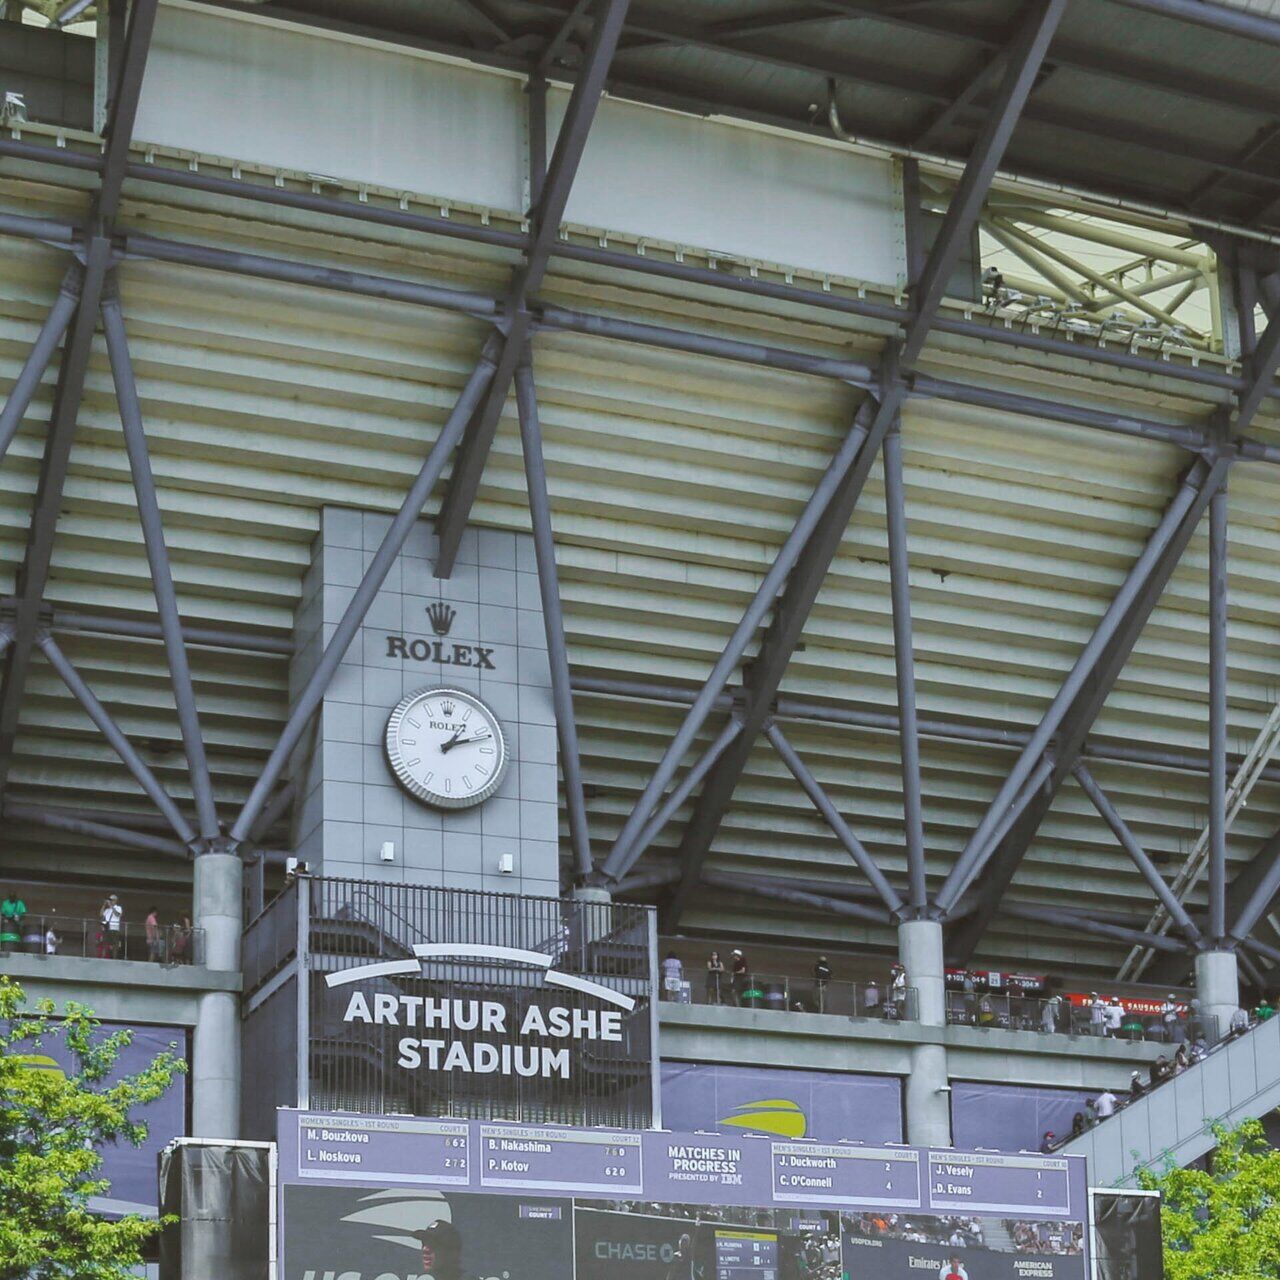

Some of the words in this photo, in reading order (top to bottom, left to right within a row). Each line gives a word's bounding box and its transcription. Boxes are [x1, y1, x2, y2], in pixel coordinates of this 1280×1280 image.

[386, 635, 496, 670] ROLEX
[429, 720, 467, 734] ROLEX
[344, 991, 506, 1033] ARTHUR
[520, 1007, 622, 1042] ASHE
[397, 1037, 570, 1079] STADIUM
[307, 1129, 319, 1140] M.
[322, 1129, 369, 1143] Bouzkova
[452, 1139, 458, 1147] 6
[460, 1139, 465, 1148] 2
[489, 1139, 498, 1150] B.
[501, 1140, 551, 1153] Nakashima
[307, 1150, 316, 1161] L.
[320, 1150, 361, 1163] Noskova
[445, 1159, 450, 1167] 2
[460, 1160, 465, 1168] 2
[668, 1146, 724, 1160] MATCHES
[728, 1150, 740, 1161] IN
[489, 1159, 498, 1170] P.
[501, 1160, 529, 1171] Kotov
[605, 1167, 611, 1175] 6
[612, 1168, 618, 1176] 2
[674, 1159, 736, 1173] PROGRESS
[779, 1157, 788, 1166] J.
[790, 1156, 836, 1169] Duckworth
[885, 1163, 890, 1171] 2
[669, 1172, 708, 1182] PRESENTED
[709, 1174, 719, 1182] BY
[721, 1173, 742, 1185] IBM
[936, 1165, 945, 1175] J.
[946, 1165, 974, 1178] Vesely
[1037, 1171, 1041, 1179] 1
[780, 1175, 789, 1185] C.
[791, 1175, 832, 1188] O'Connell
[886, 1182, 892, 1190] 4
[937, 1184, 946, 1193] D.
[948, 1184, 972, 1195] Evans
[1037, 1190, 1042, 1198] 2
[595, 1242, 657, 1260] CHASE
[908, 1255, 941, 1270] Emirates
[1013, 1260, 1053, 1270] AMERICAN
[1019, 1269, 1053, 1278] EXPRESS
